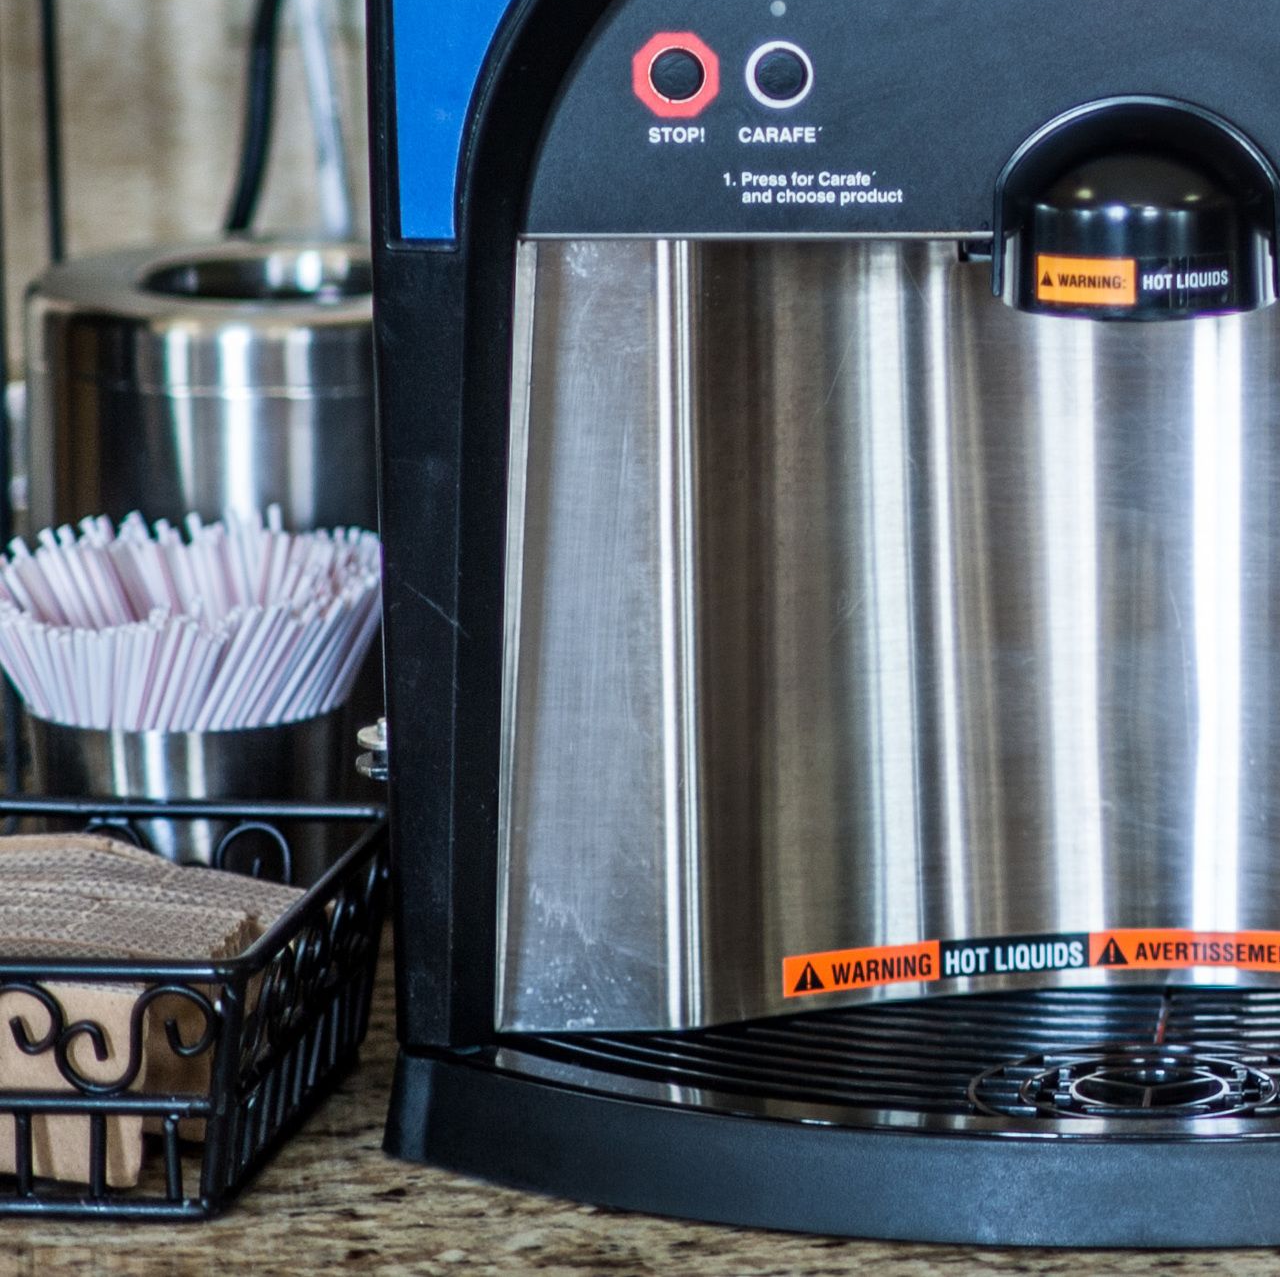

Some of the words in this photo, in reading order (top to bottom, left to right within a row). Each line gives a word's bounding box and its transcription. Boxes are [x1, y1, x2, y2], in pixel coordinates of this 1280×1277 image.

[648, 126, 705, 143] STOP!
[723, 172, 737, 186] 1.
[741, 172, 787, 186] Press
[791, 172, 814, 186] for
[742, 189, 772, 203] and
[776, 189, 835, 203] choose
[840, 189, 903, 206] product
[1057, 272, 1127, 290] WARNING:
[1142, 274, 1173, 290] HOT
[1176, 270, 1228, 289] LIQUIDS
[832, 953, 932, 986] WARNING
[945, 947, 990, 975] HOT
[995, 941, 1084, 971] LIQUIDS
